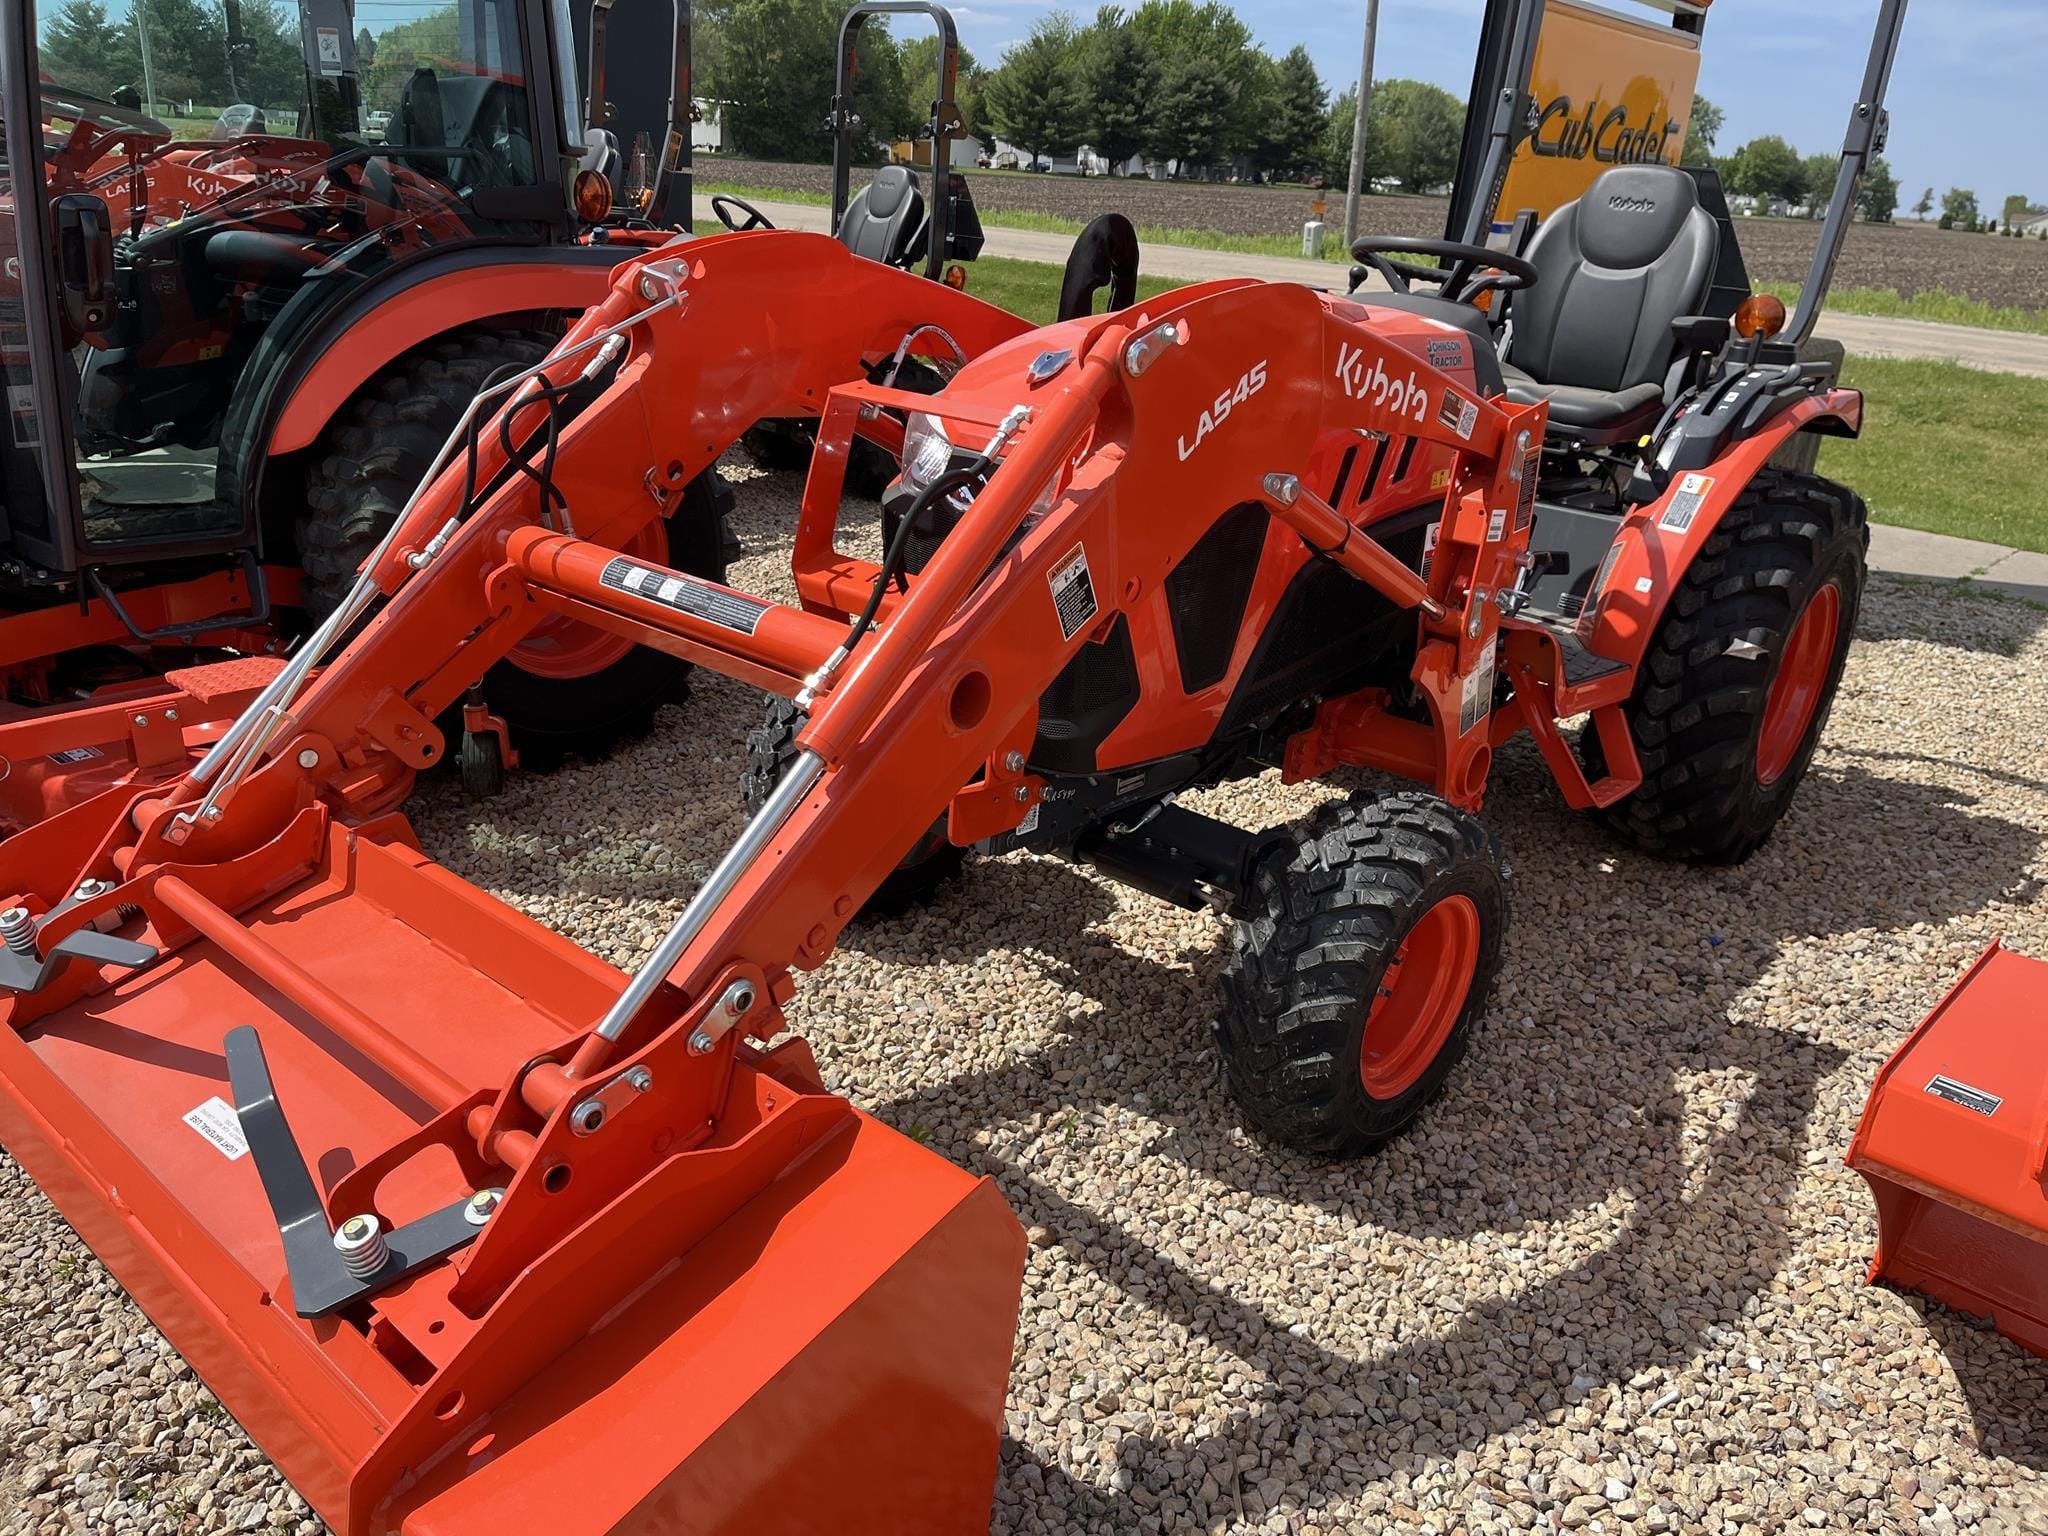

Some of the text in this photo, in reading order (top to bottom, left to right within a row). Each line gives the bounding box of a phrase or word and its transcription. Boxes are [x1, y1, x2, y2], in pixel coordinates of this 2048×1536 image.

[1531, 96, 1681, 165] Cub Cadet
[1608, 195, 1656, 213] Kubota
[1427, 338, 1461, 353] JOHNSON
[1429, 353, 1463, 368] TRACTOR
[1335, 342, 1428, 423] Kubota
[1178, 360, 1267, 462] LA545
[1054, 548, 1081, 575] WARNING
[189, 1115, 239, 1155] LIGHT MATERIAL USE
